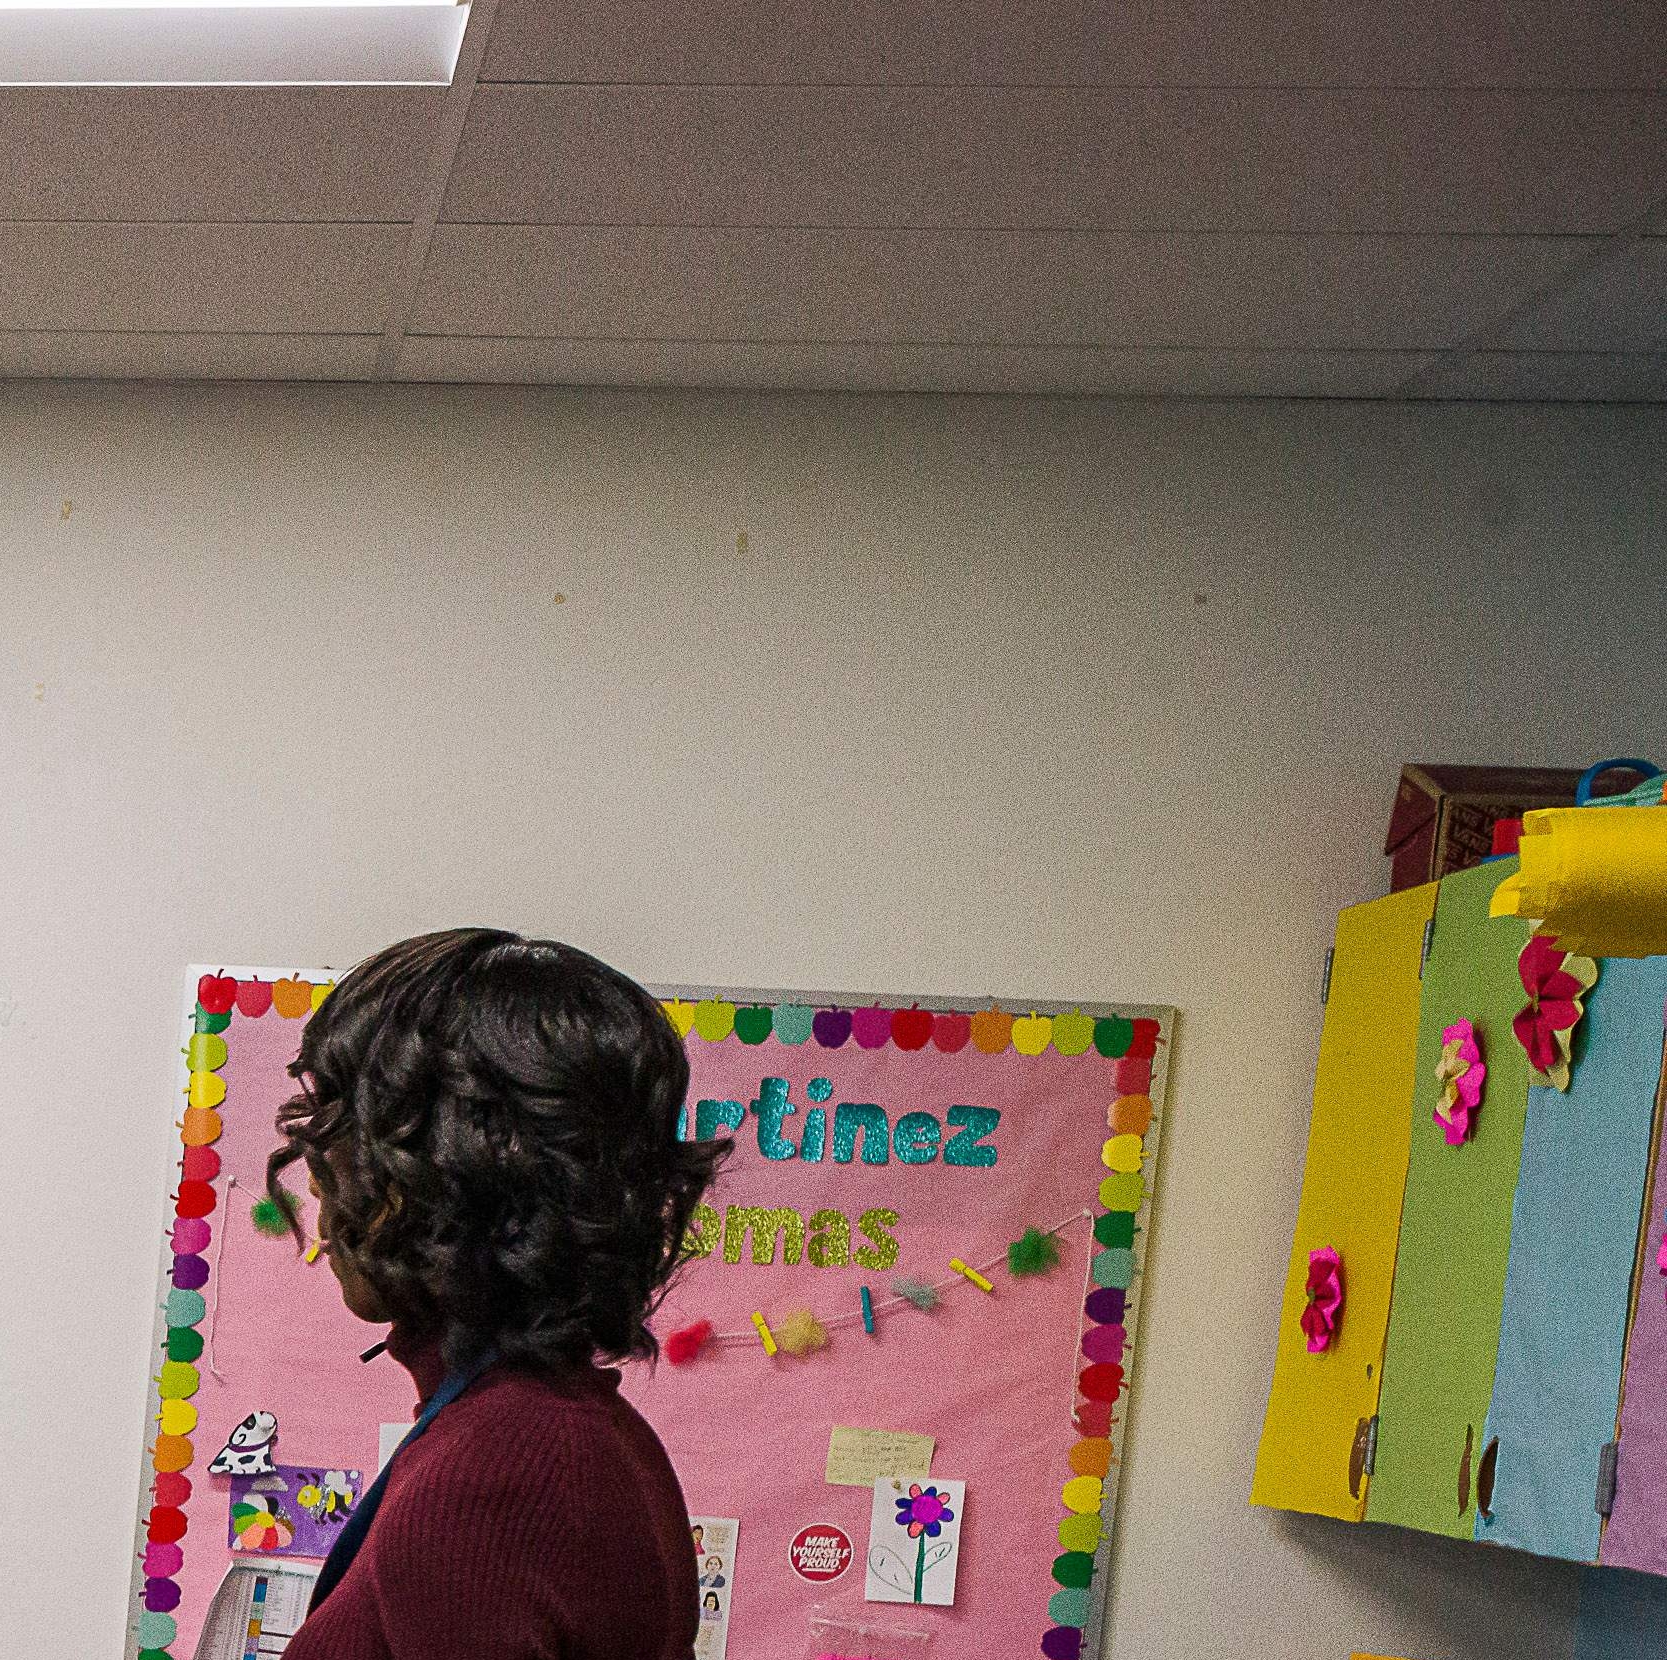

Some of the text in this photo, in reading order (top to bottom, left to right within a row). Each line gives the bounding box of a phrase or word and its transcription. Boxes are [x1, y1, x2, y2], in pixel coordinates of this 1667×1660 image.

[677, 1077, 1002, 1168] rtinez
[804, 1536, 839, 1548] MAKE
[793, 1544, 850, 1559] YOURSELF
